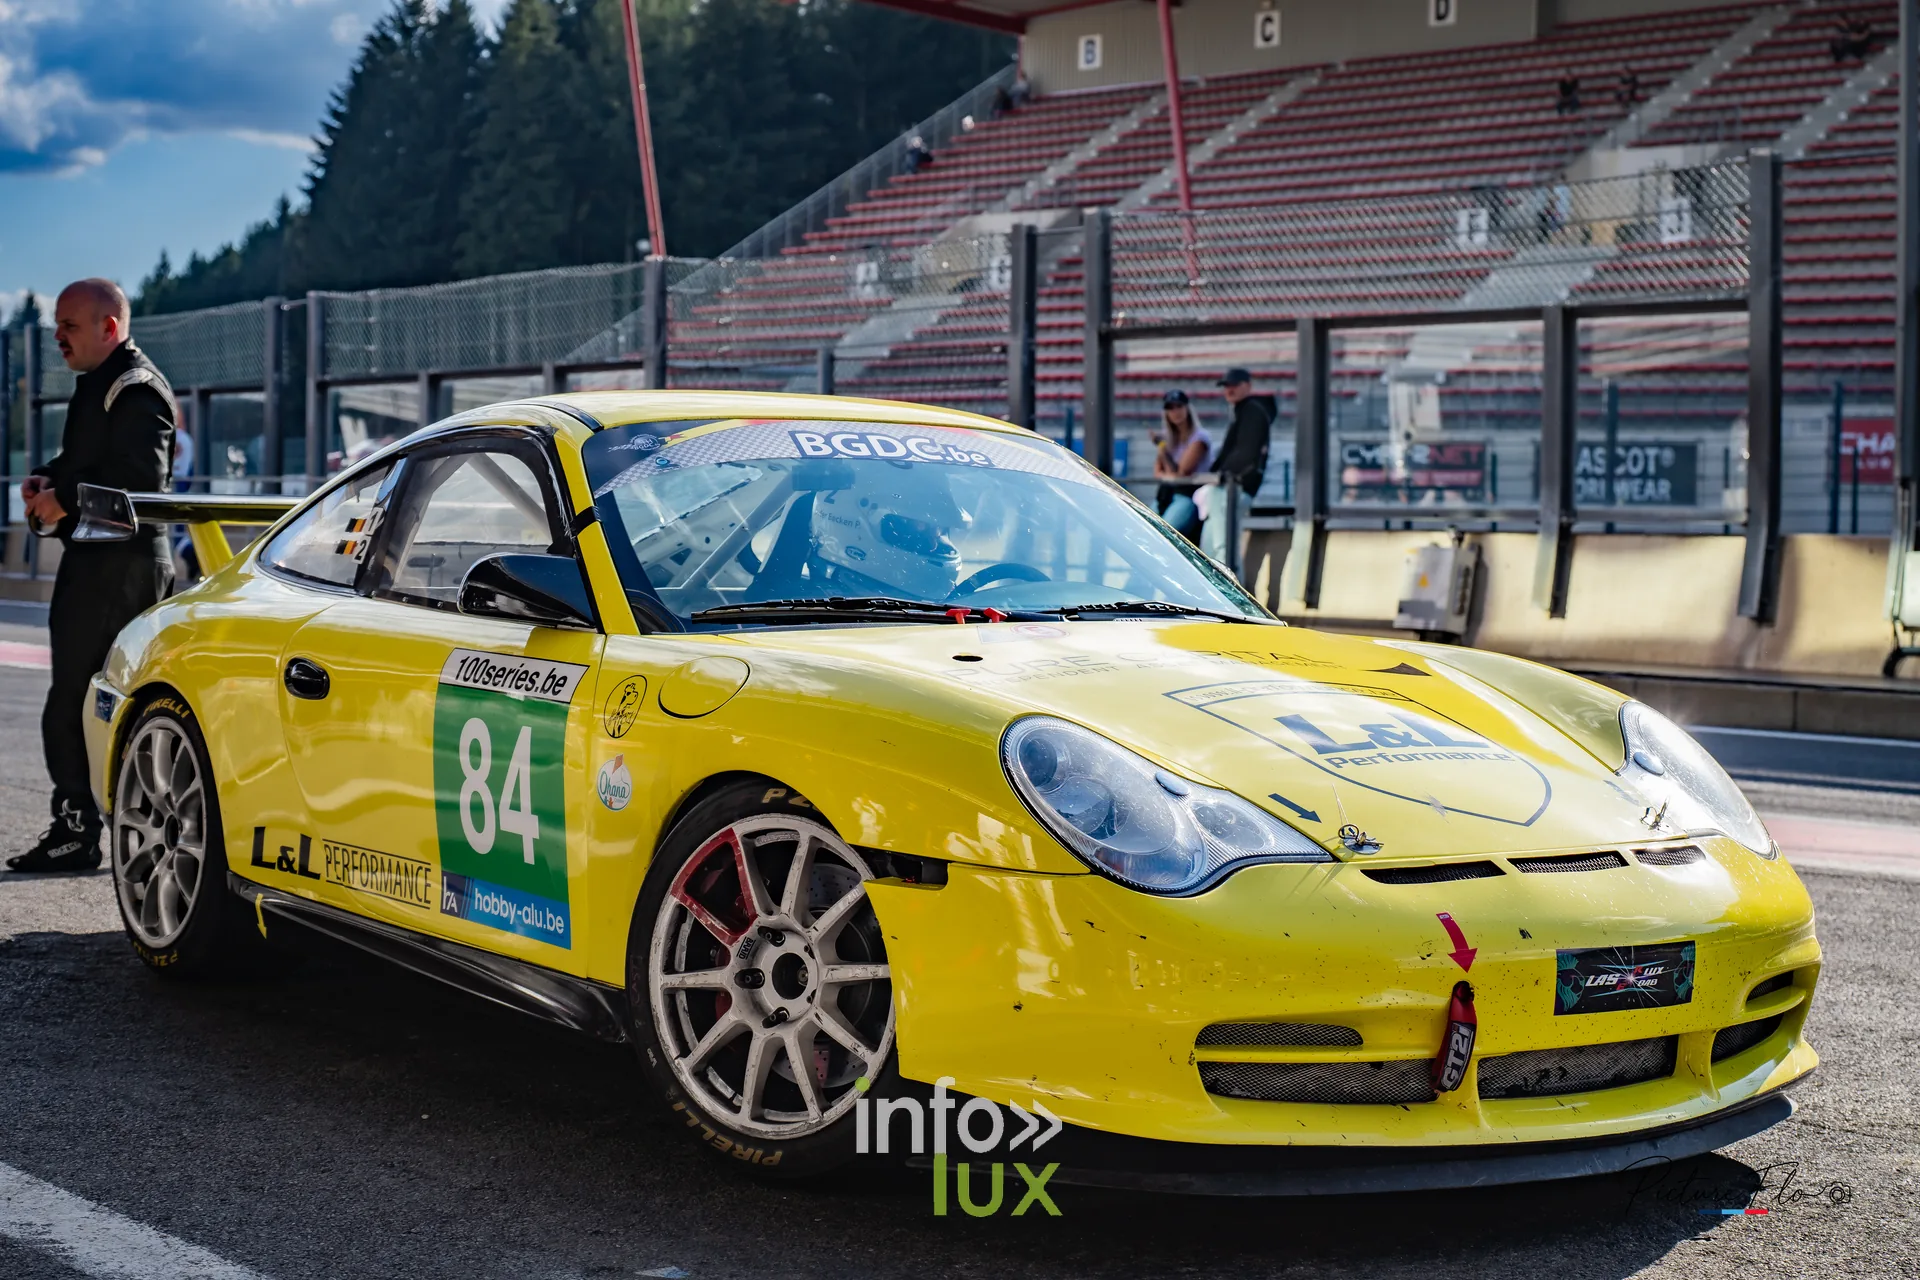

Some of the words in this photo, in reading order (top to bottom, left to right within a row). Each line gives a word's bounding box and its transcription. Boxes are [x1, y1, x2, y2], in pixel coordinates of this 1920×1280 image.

[1435, 0, 1449, 21] D
[1260, 16, 1275, 43] C
[1084, 39, 1097, 65] B
[794, 432, 989, 465] BGDC.be
[368, 511, 379, 532] 1
[354, 539, 367, 561] 2
[455, 654, 568, 696] 100series.be
[944, 655, 1109, 680] PURE
[143, 697, 190, 718] PIRELLI
[1273, 711, 1490, 755] L&L
[1324, 752, 1515, 769] Performance
[459, 717, 540, 865] 84
[599, 770, 629, 799] Ohana
[250, 826, 321, 880] L&L
[323, 843, 431, 905] PERFORMANCE
[475, 887, 565, 935] hobby-alu.be
[738, 937, 754, 961] BRAID
[671, 1101, 783, 1166] PIRELLI
